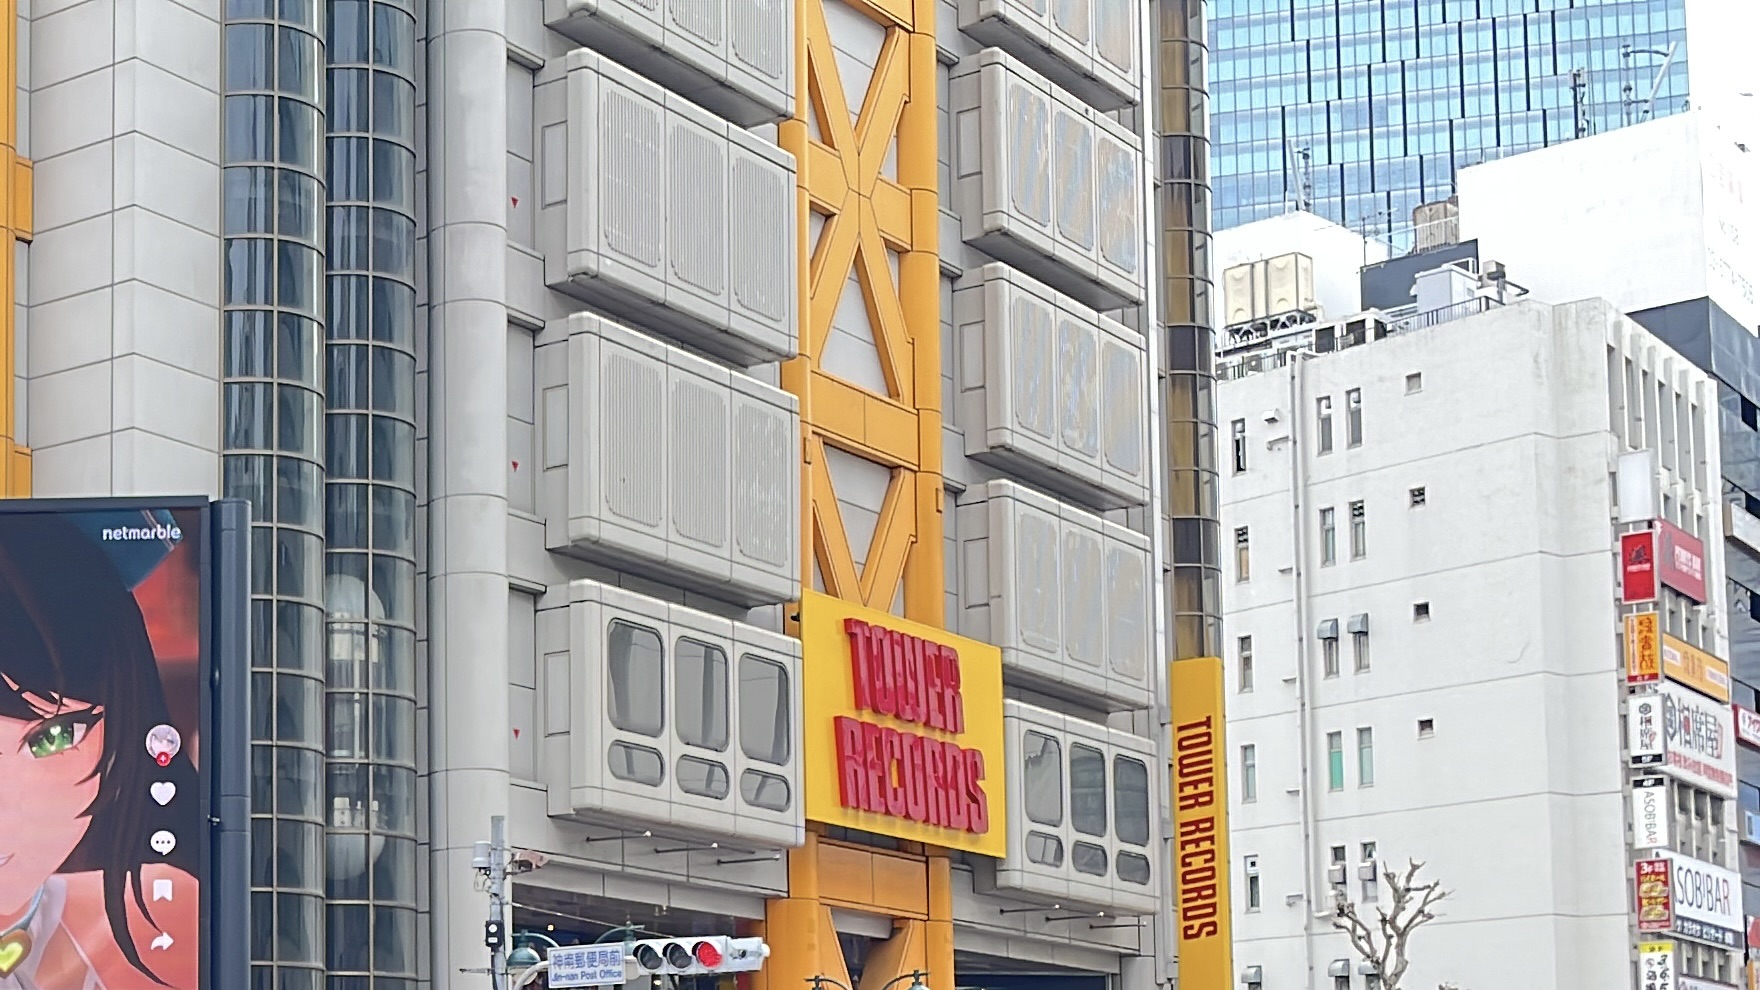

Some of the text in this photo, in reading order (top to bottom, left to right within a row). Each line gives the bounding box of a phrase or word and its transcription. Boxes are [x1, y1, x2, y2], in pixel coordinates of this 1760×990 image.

[102, 524, 182, 542] netmarble
[844, 617, 965, 735] TOWER
[834, 715, 989, 836] RECORDS
[1177, 715, 1219, 941] TOWER RECORDS
